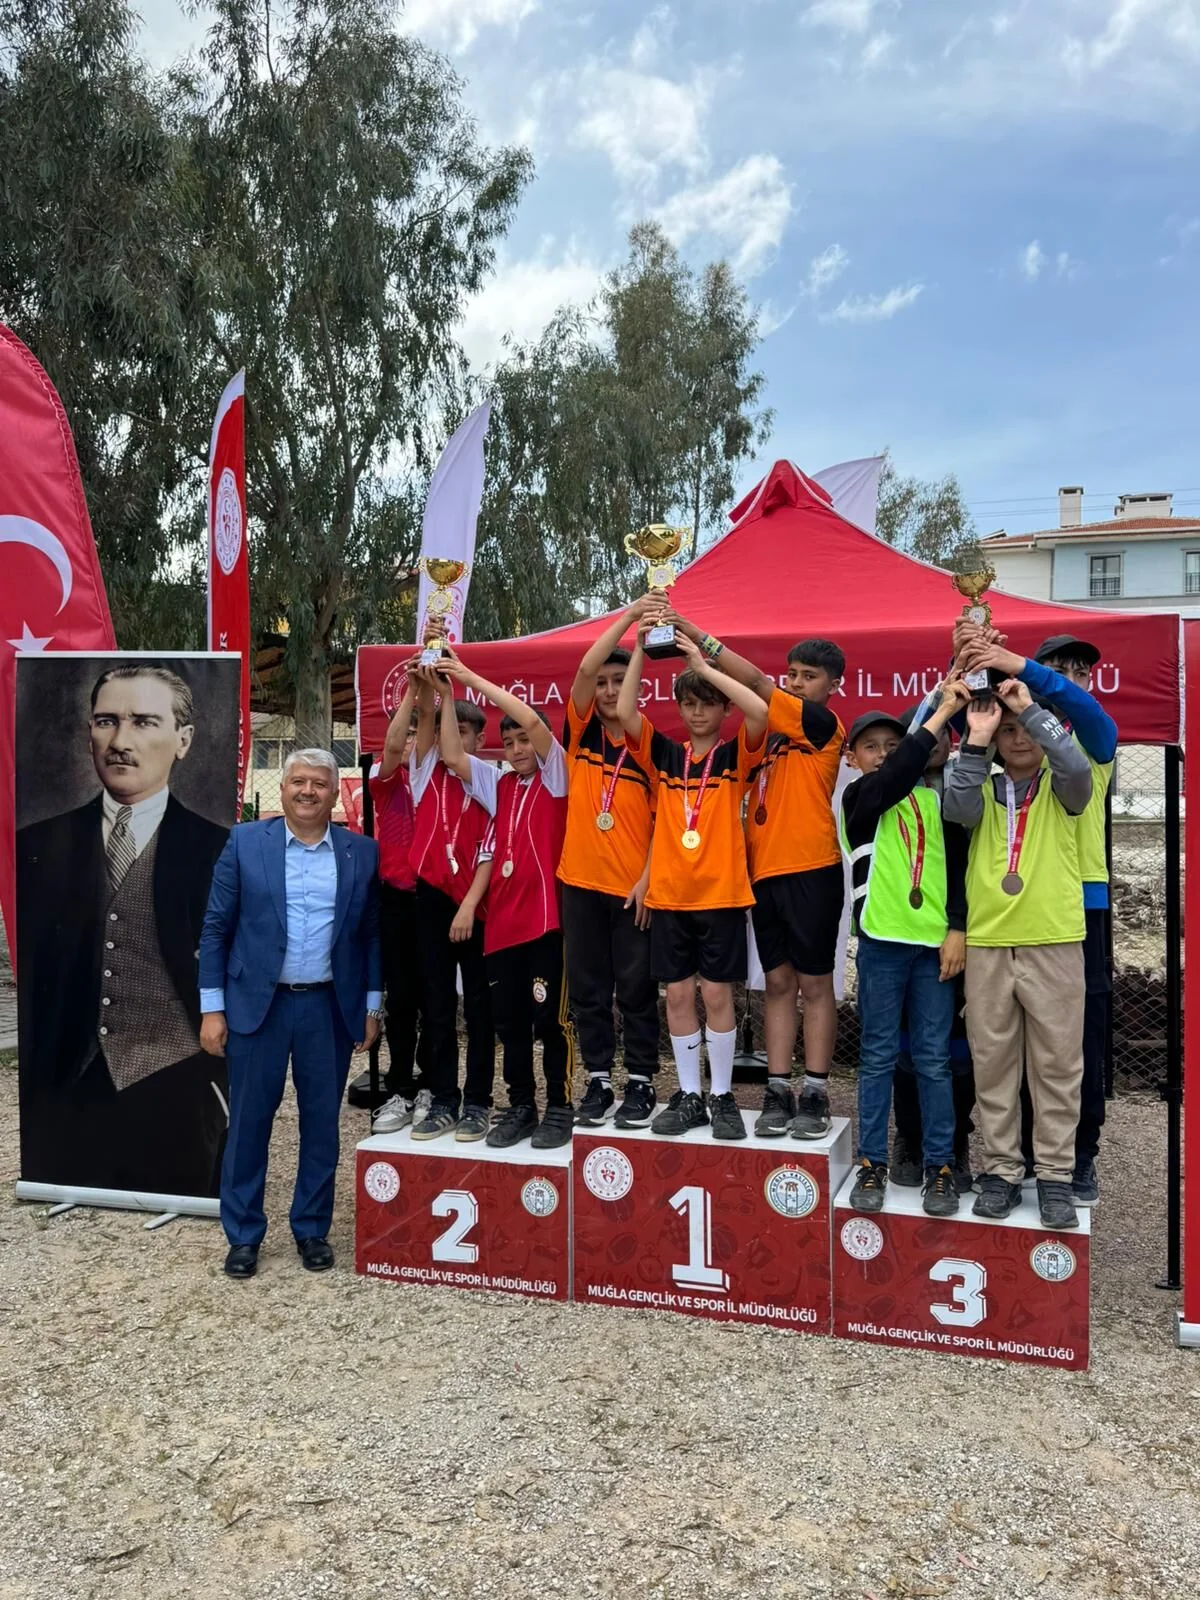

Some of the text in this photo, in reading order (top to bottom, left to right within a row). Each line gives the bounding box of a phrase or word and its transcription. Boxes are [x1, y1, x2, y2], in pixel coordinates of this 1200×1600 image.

[857, 668, 883, 697] İL
[431, 1189, 480, 1264] 2
[668, 1185, 731, 1293] 1
[367, 1262, 557, 1295] MUĞLA GENÇLİK VE SPOR İL MÜDÜRLÜĞÜ
[929, 1257, 987, 1328] 3
[588, 1284, 817, 1323] MUĞLA GENÇLİK VE SPOR İL MÜDÜRLÜĞÜ
[848, 1322, 1075, 1361] MUĞLA GENÇLİK VE SPOR İL MÜDÜRLÜĞÜ
